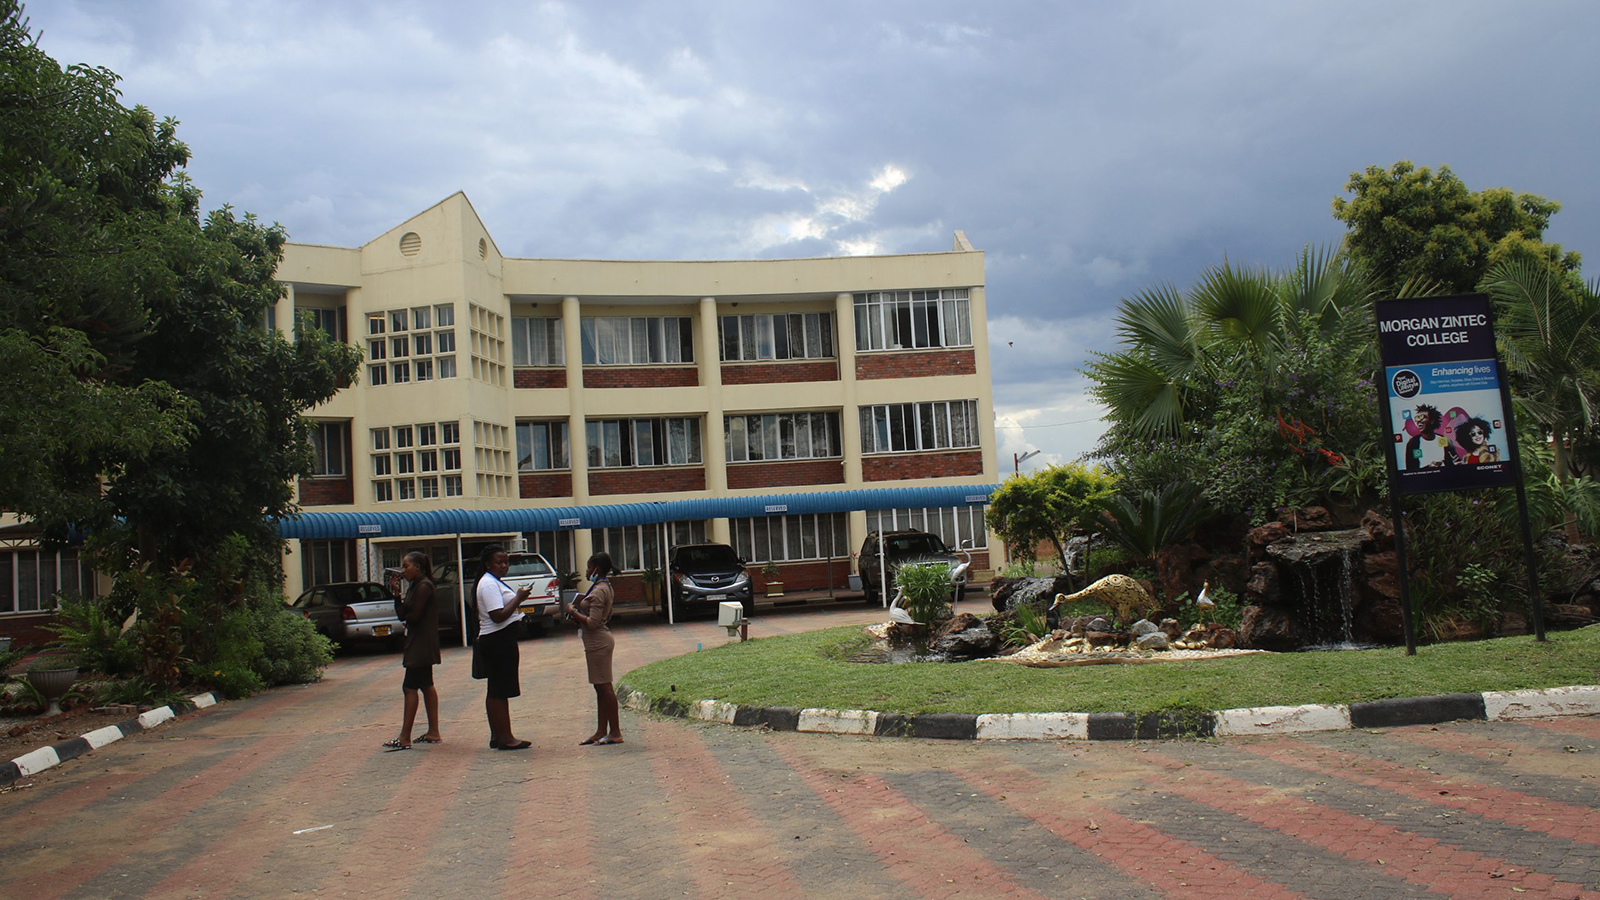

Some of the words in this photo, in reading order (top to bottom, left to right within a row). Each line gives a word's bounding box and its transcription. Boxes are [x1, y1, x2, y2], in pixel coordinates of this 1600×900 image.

[1380, 317, 1439, 333] MORGAN
[1441, 314, 1487, 328] ZINTEC
[1407, 331, 1469, 347] COLLEGE
[1432, 366, 1474, 377] Enhancing
[1474, 365, 1491, 374] lives
[1396, 376, 1416, 387] Digital
[1397, 382, 1419, 392] Lifestyle
